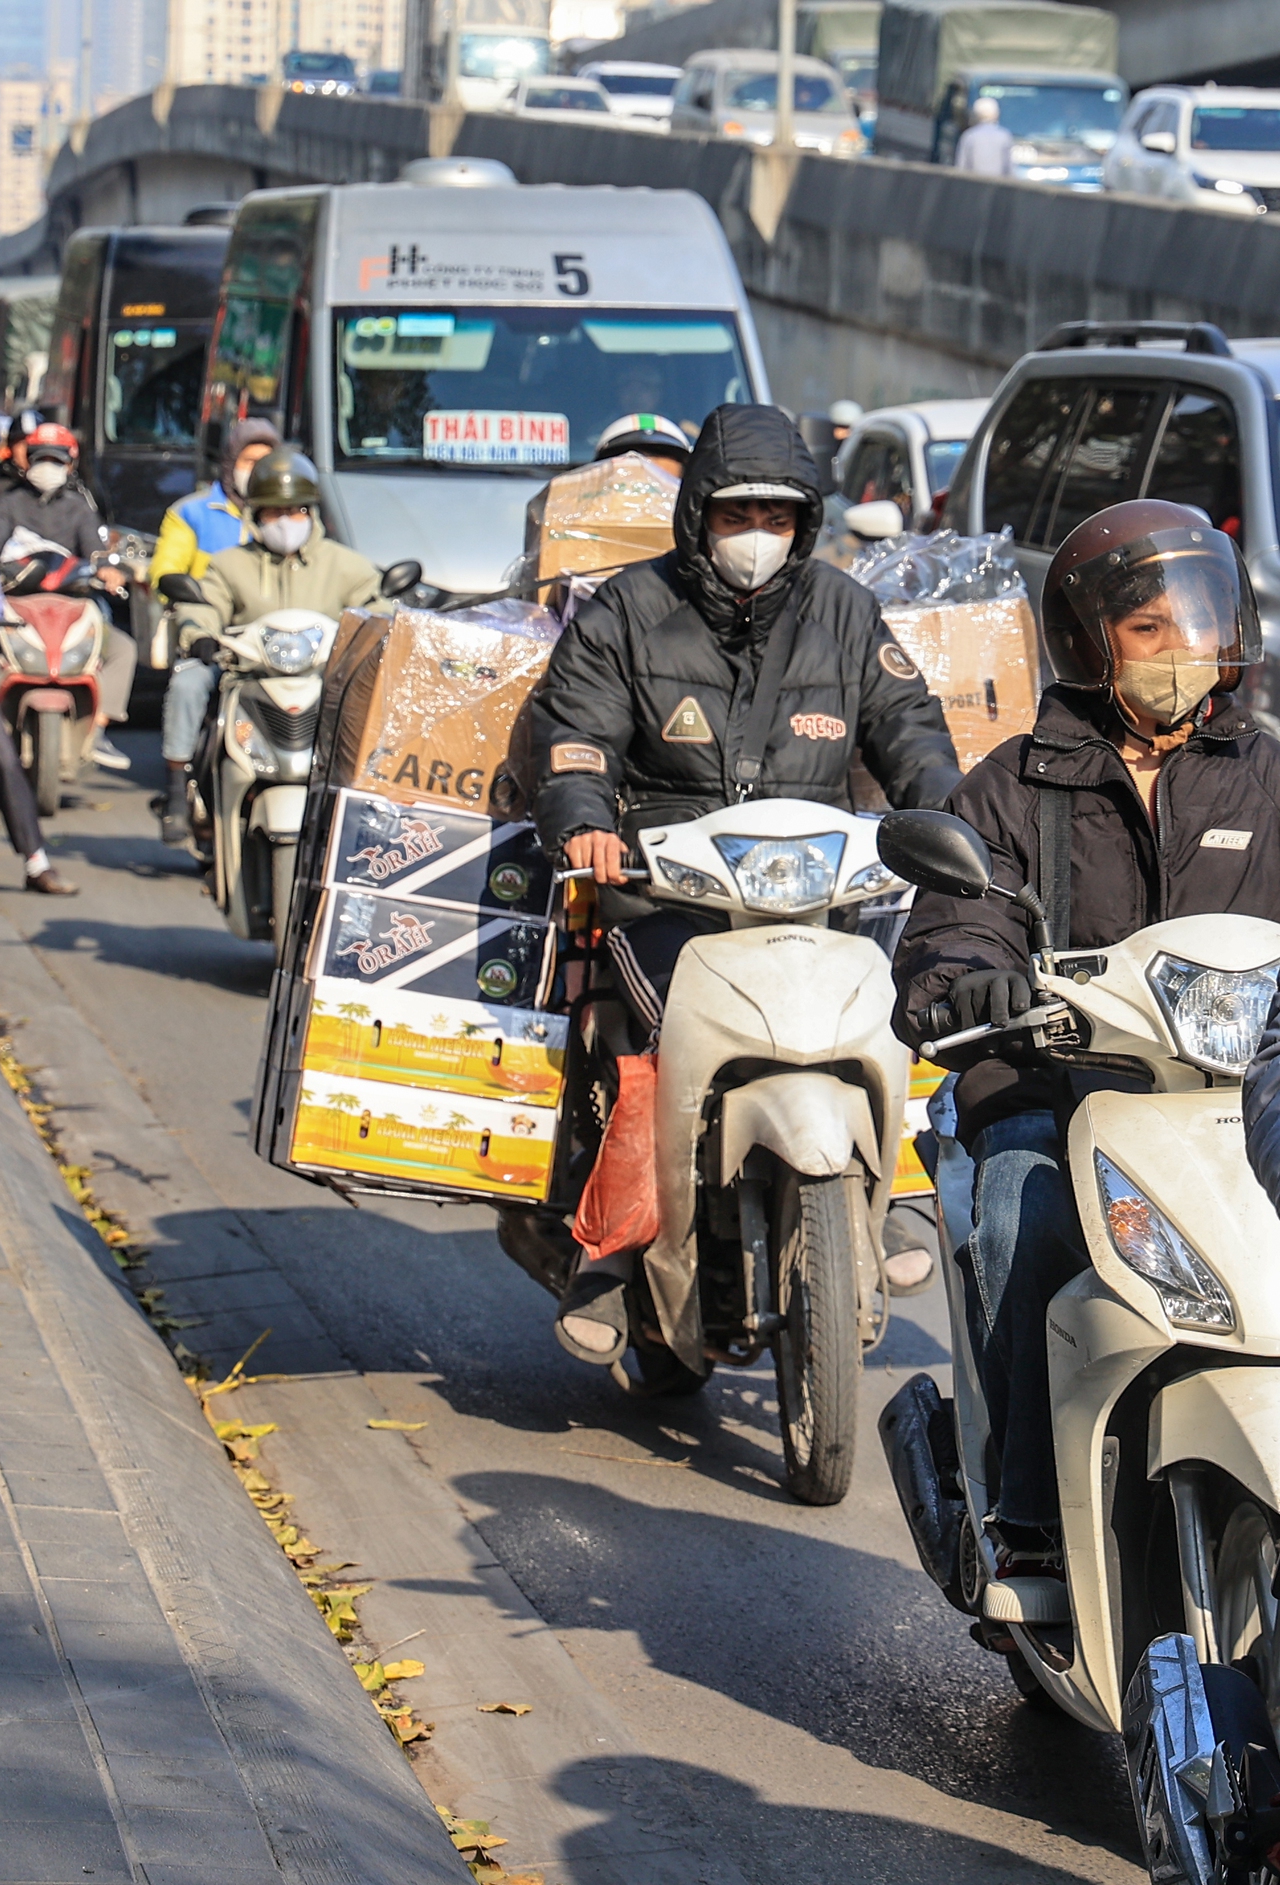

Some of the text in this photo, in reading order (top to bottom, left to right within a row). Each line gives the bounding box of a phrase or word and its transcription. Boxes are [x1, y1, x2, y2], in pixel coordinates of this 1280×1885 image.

[552, 253, 589, 297] 5
[426, 411, 567, 443] THÁI BÌNH
[948, 693, 981, 708] PORT
[366, 747, 520, 812] CARGO
[766, 934, 817, 945] HONDA
[1215, 1116, 1242, 1125] HO
[1049, 1318, 1078, 1349] HONDA
